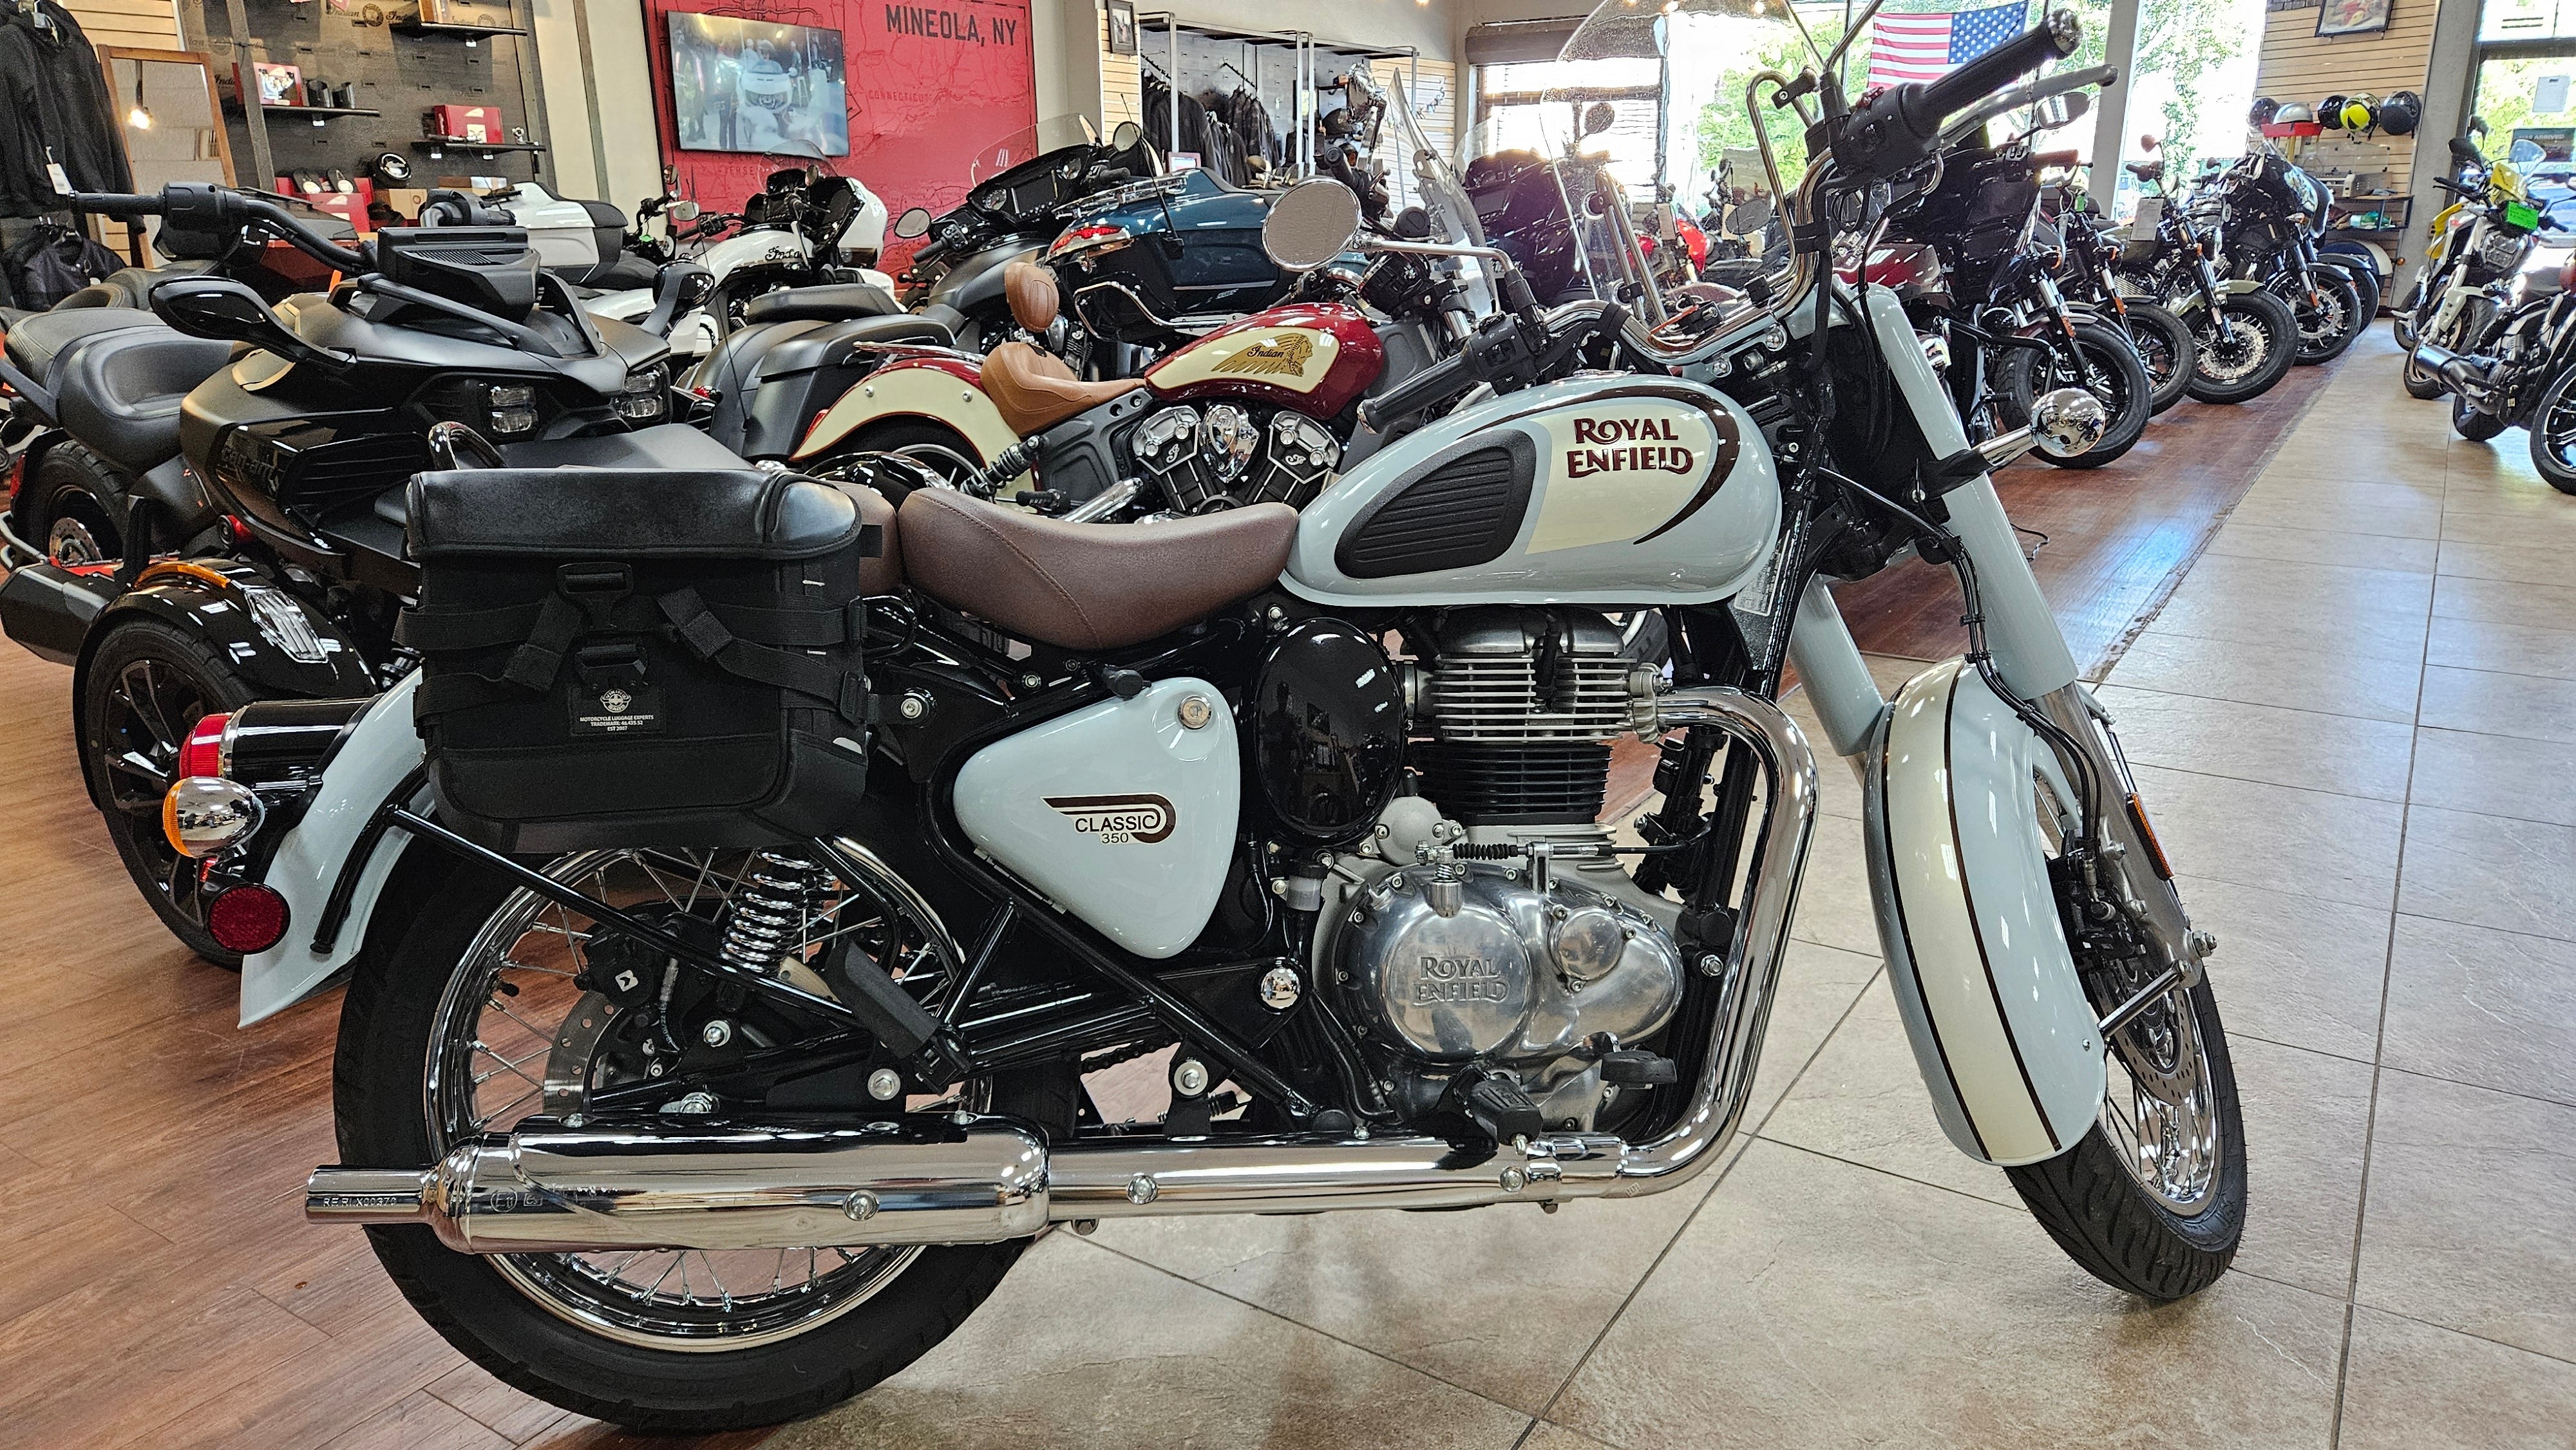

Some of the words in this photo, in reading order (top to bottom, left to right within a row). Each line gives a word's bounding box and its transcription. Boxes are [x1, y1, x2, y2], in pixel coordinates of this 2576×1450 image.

[886, 4, 985, 46] MINEOLA,
[992, 17, 1016, 46] NY
[1247, 346, 1284, 358] Indian
[1573, 419, 1679, 445] ROYAL
[1567, 447, 1694, 478] ENFIELD
[605, 690, 627, 699] VIKING
[1075, 814, 1160, 833] CLASSIC
[1102, 833, 1129, 843] 350
[1421, 957, 1500, 982] ROYAL
[1413, 982, 1510, 1006] ENFIELD
